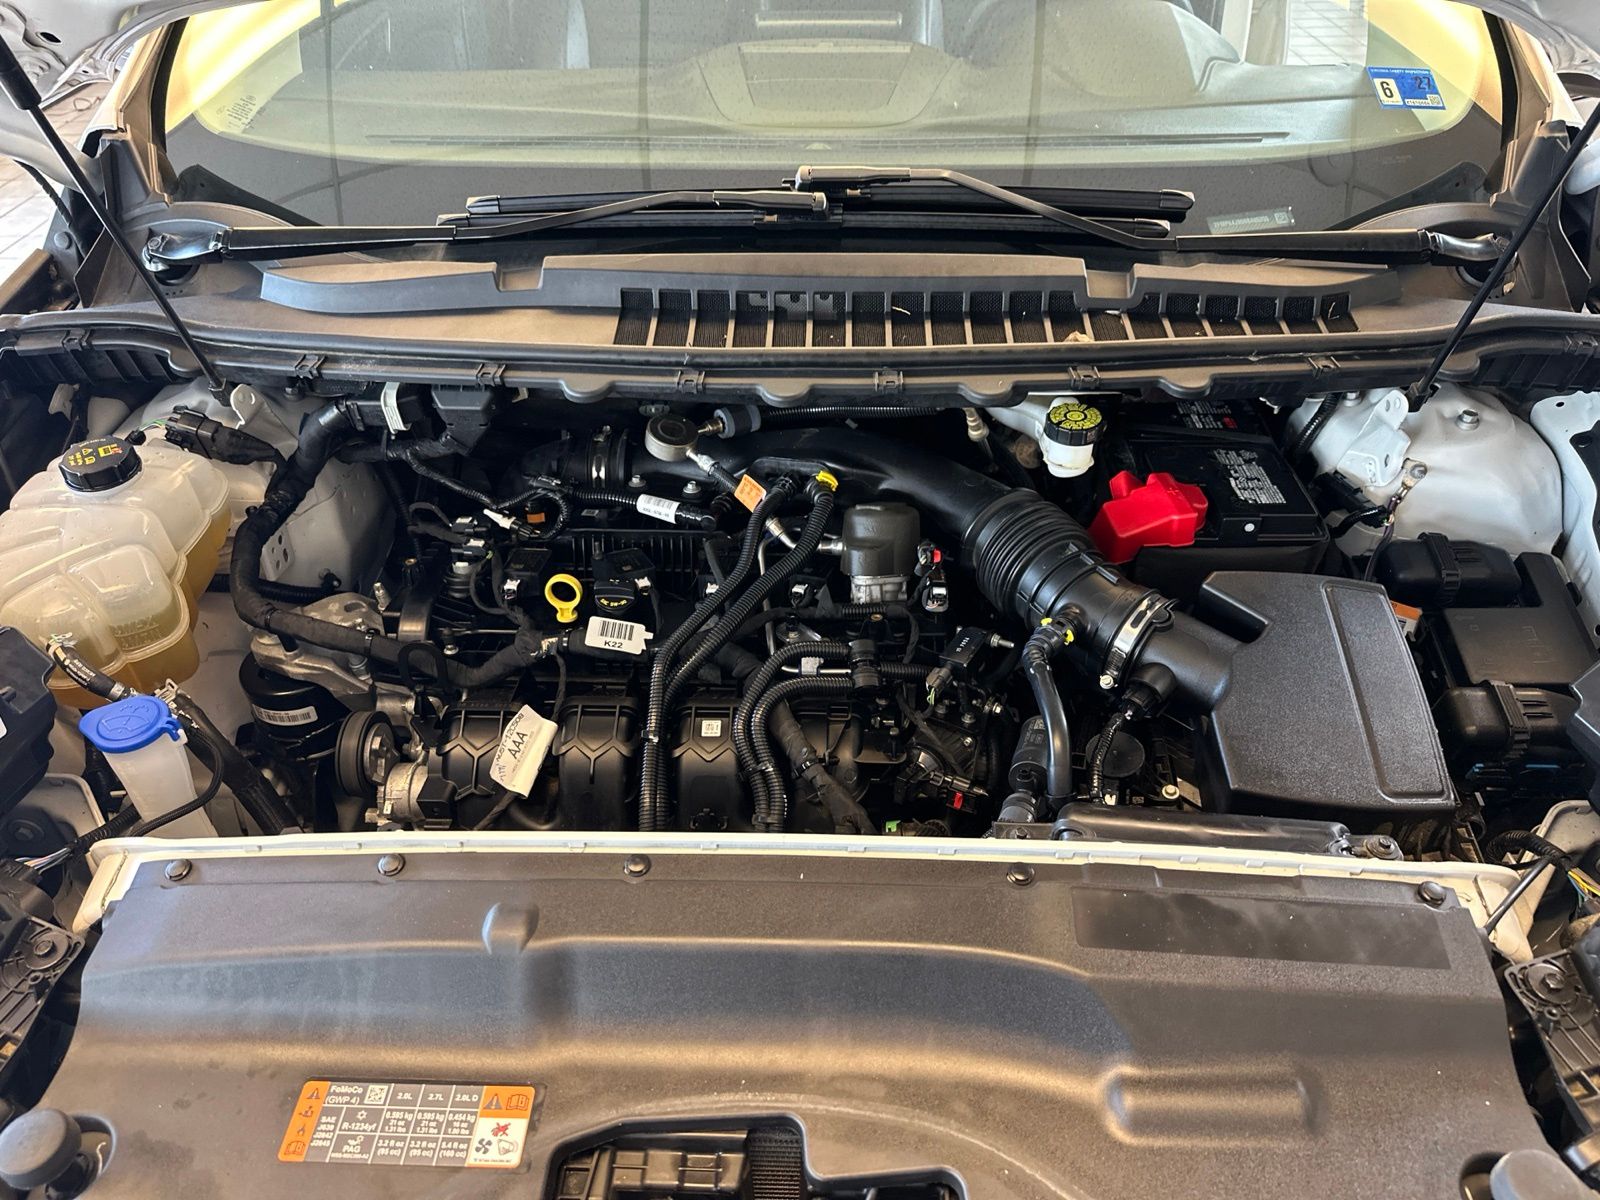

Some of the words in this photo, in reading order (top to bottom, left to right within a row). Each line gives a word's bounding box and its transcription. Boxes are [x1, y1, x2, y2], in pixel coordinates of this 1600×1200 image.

[1414, 76, 1431, 90] 27
[1379, 80, 1394, 98] 6
[603, 640, 624, 649] K22
[507, 731, 528, 760] AAA
[330, 1085, 363, 1094] FoMoCo
[325, 1096, 350, 1105] (GWP
[350, 1096, 360, 1105] 4)
[397, 1092, 413, 1100] 2.0L
[427, 1093, 444, 1101] 2.7L
[404, 1111, 414, 1121] kg
[435, 1112, 445, 1122] kg
[467, 1113, 476, 1123] kg
[341, 1122, 377, 1132] R-1234yf
[342, 1145, 360, 1153] PAG
